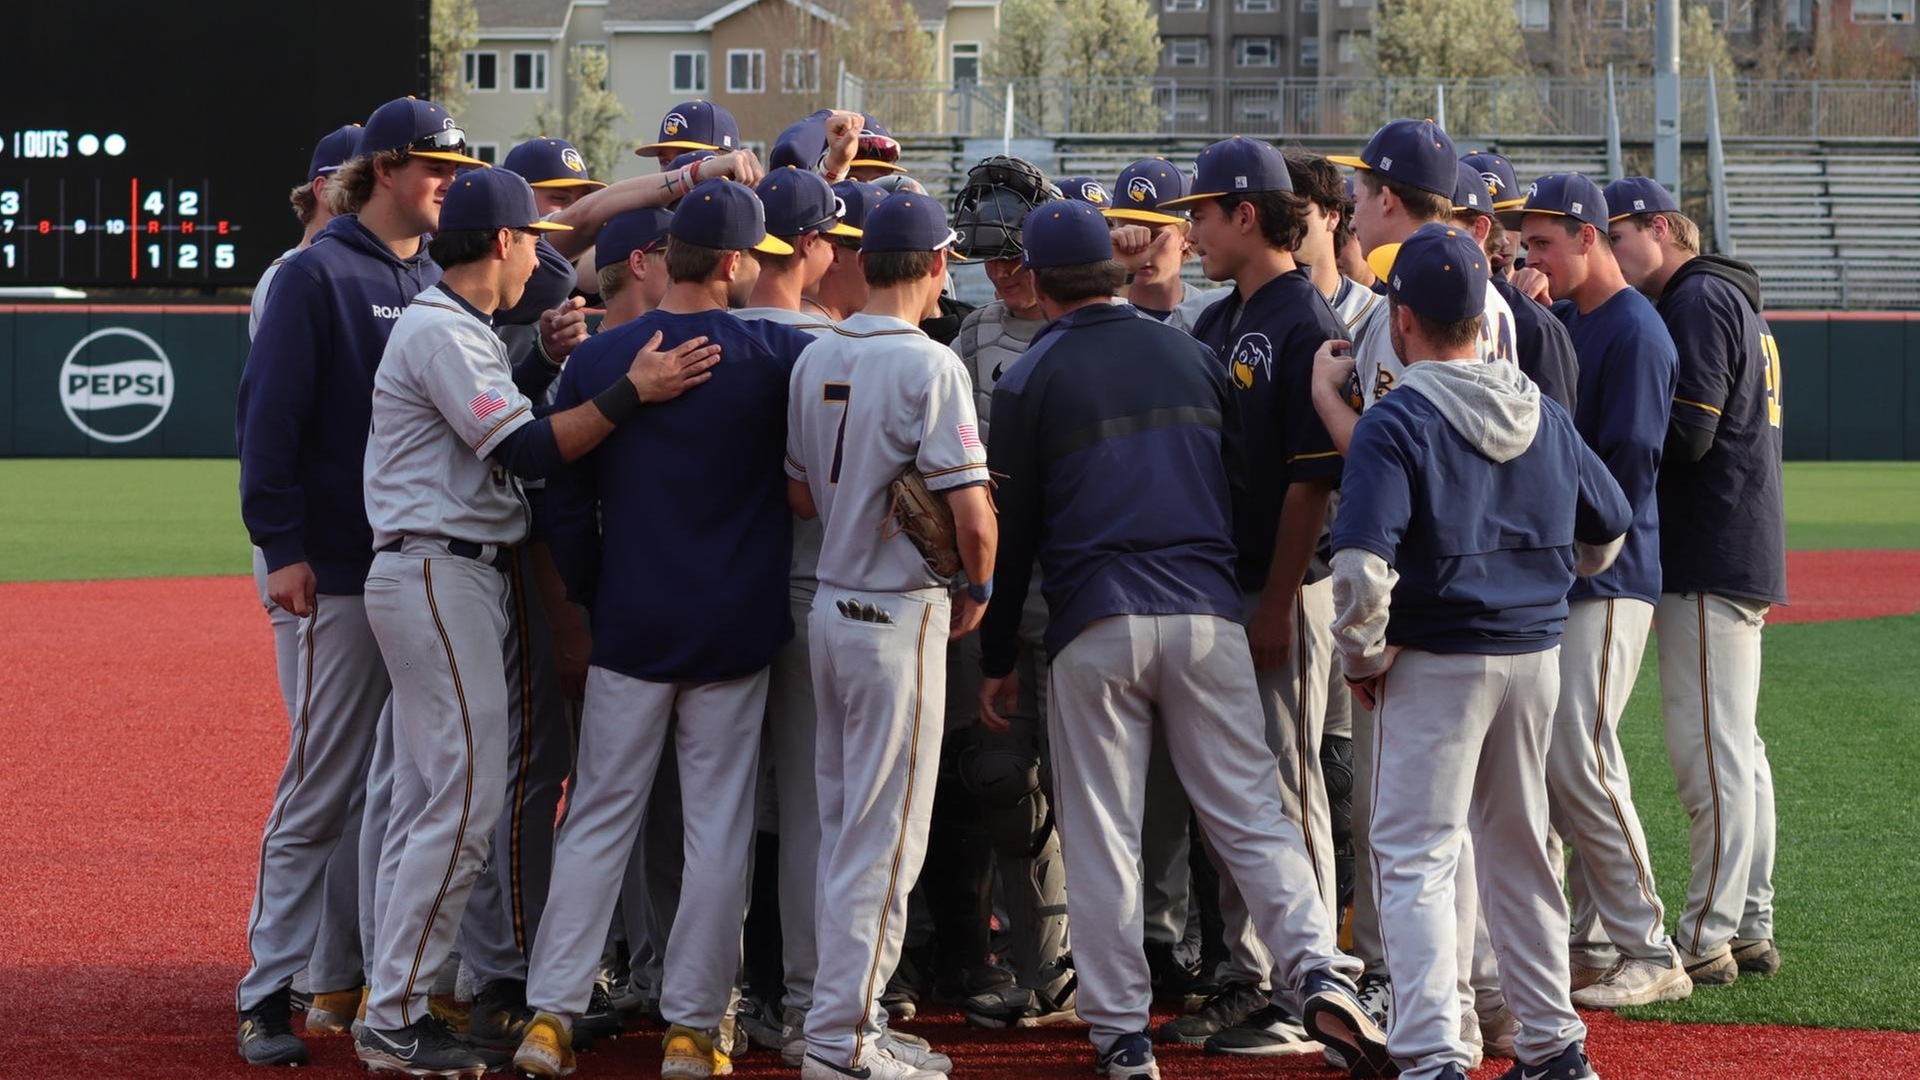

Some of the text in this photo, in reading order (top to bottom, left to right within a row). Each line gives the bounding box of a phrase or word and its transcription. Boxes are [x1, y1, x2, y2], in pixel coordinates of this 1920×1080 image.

[24, 130, 69, 158] OUTS
[0, 191, 198, 216] 3 4 2
[3, 219, 229, 234] 7 8 9 10 R H E
[3, 244, 235, 268] 1 1 2 5
[69, 374, 164, 396] PEPSI
[822, 381, 851, 486] 7
